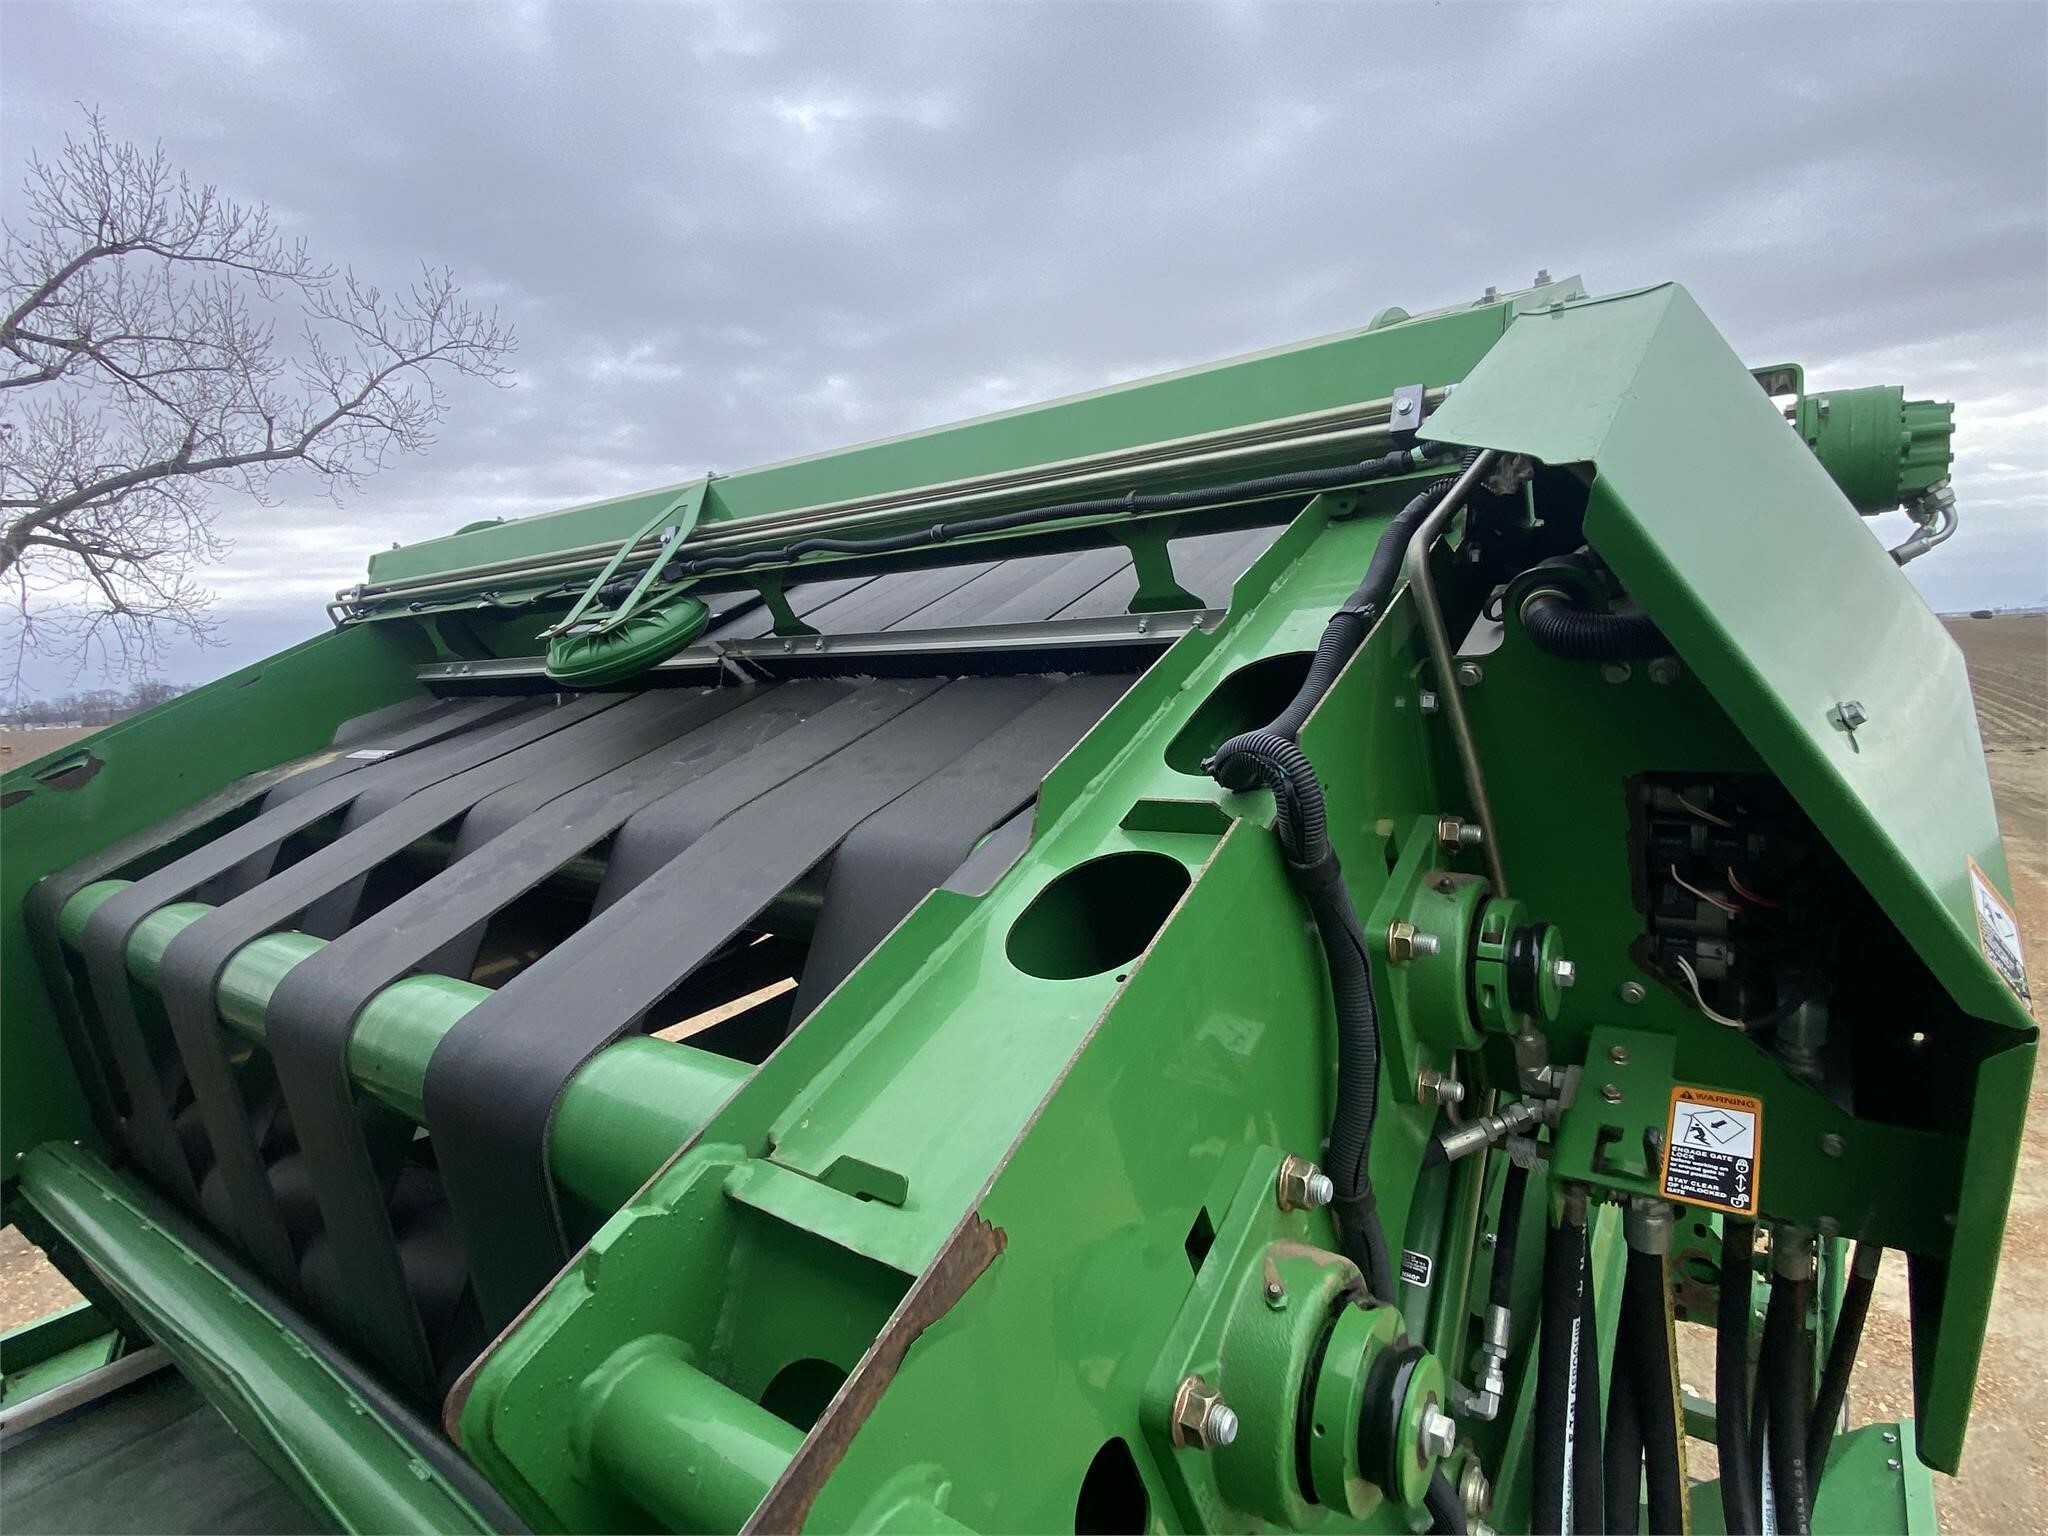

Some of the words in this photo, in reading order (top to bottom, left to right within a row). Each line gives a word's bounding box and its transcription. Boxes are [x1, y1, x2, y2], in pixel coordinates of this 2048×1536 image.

[1695, 1094, 1755, 1108] WARNING
[1671, 1152, 1695, 1160] LOCK
[1672, 1146, 1708, 1157] ENGAGE
[1710, 1153, 1733, 1162] GATE
[1678, 1163, 1702, 1172] around
[1702, 1168, 1717, 1176] gate
[1693, 1161, 1718, 1172] working
[1668, 1176, 1689, 1185] STAY
[1691, 1180, 1719, 1191] CLEAR
[1667, 1187, 1685, 1195] GATE
[1680, 1184, 1727, 1198] UNLOCKED
